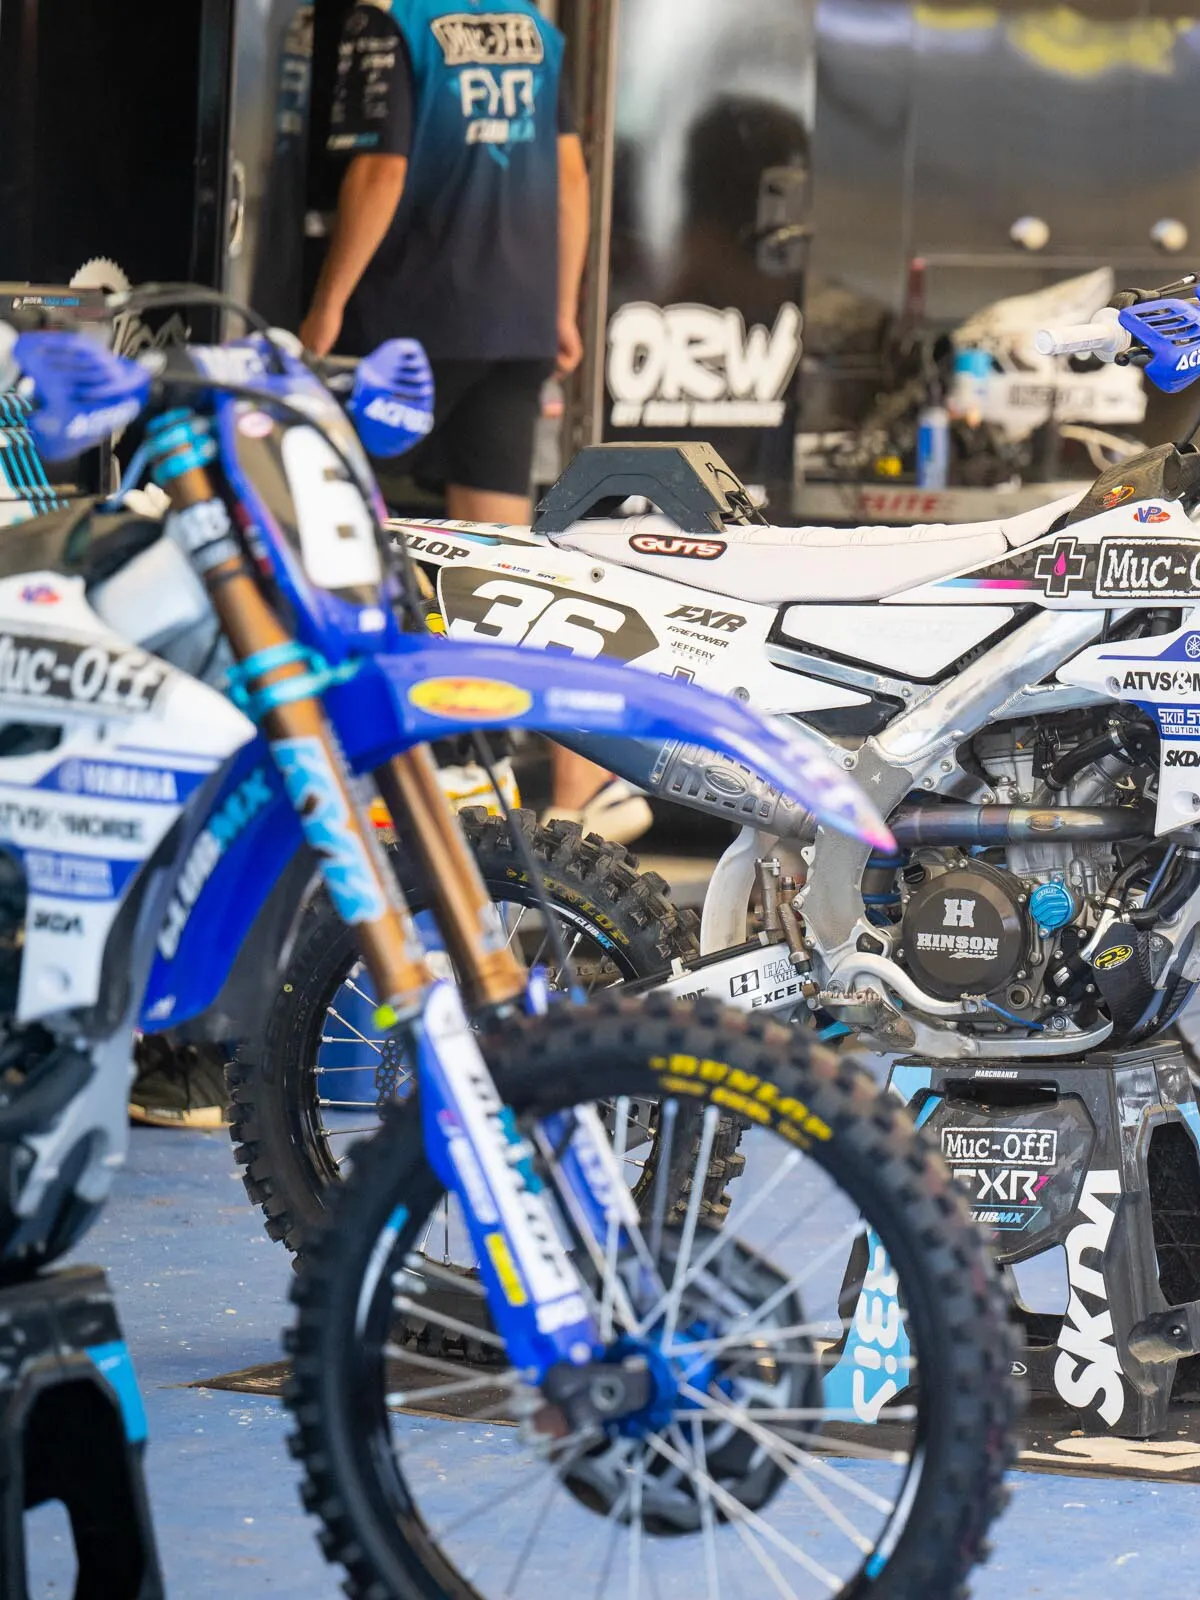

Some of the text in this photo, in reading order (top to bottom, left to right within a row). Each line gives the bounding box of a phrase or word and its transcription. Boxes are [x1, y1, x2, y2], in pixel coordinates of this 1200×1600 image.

[633, 536, 722, 555] GUTS
[664, 604, 747, 632] FXR
[690, 632, 729, 648] POWER
[671, 641, 716, 660] JEFFERY
[1158, 708, 1184, 724] SKID
[942, 898, 976, 928] H
[575, 917, 615, 950] CLUBMX
[917, 933, 999, 951] HINSON
[975, 1070, 1018, 1079] MARCHBANKS
[945, 1133, 1051, 1160] Muc-Off
[971, 1211, 1025, 1223] LUBMX
[1054, 1169, 1124, 1428] SKDA
